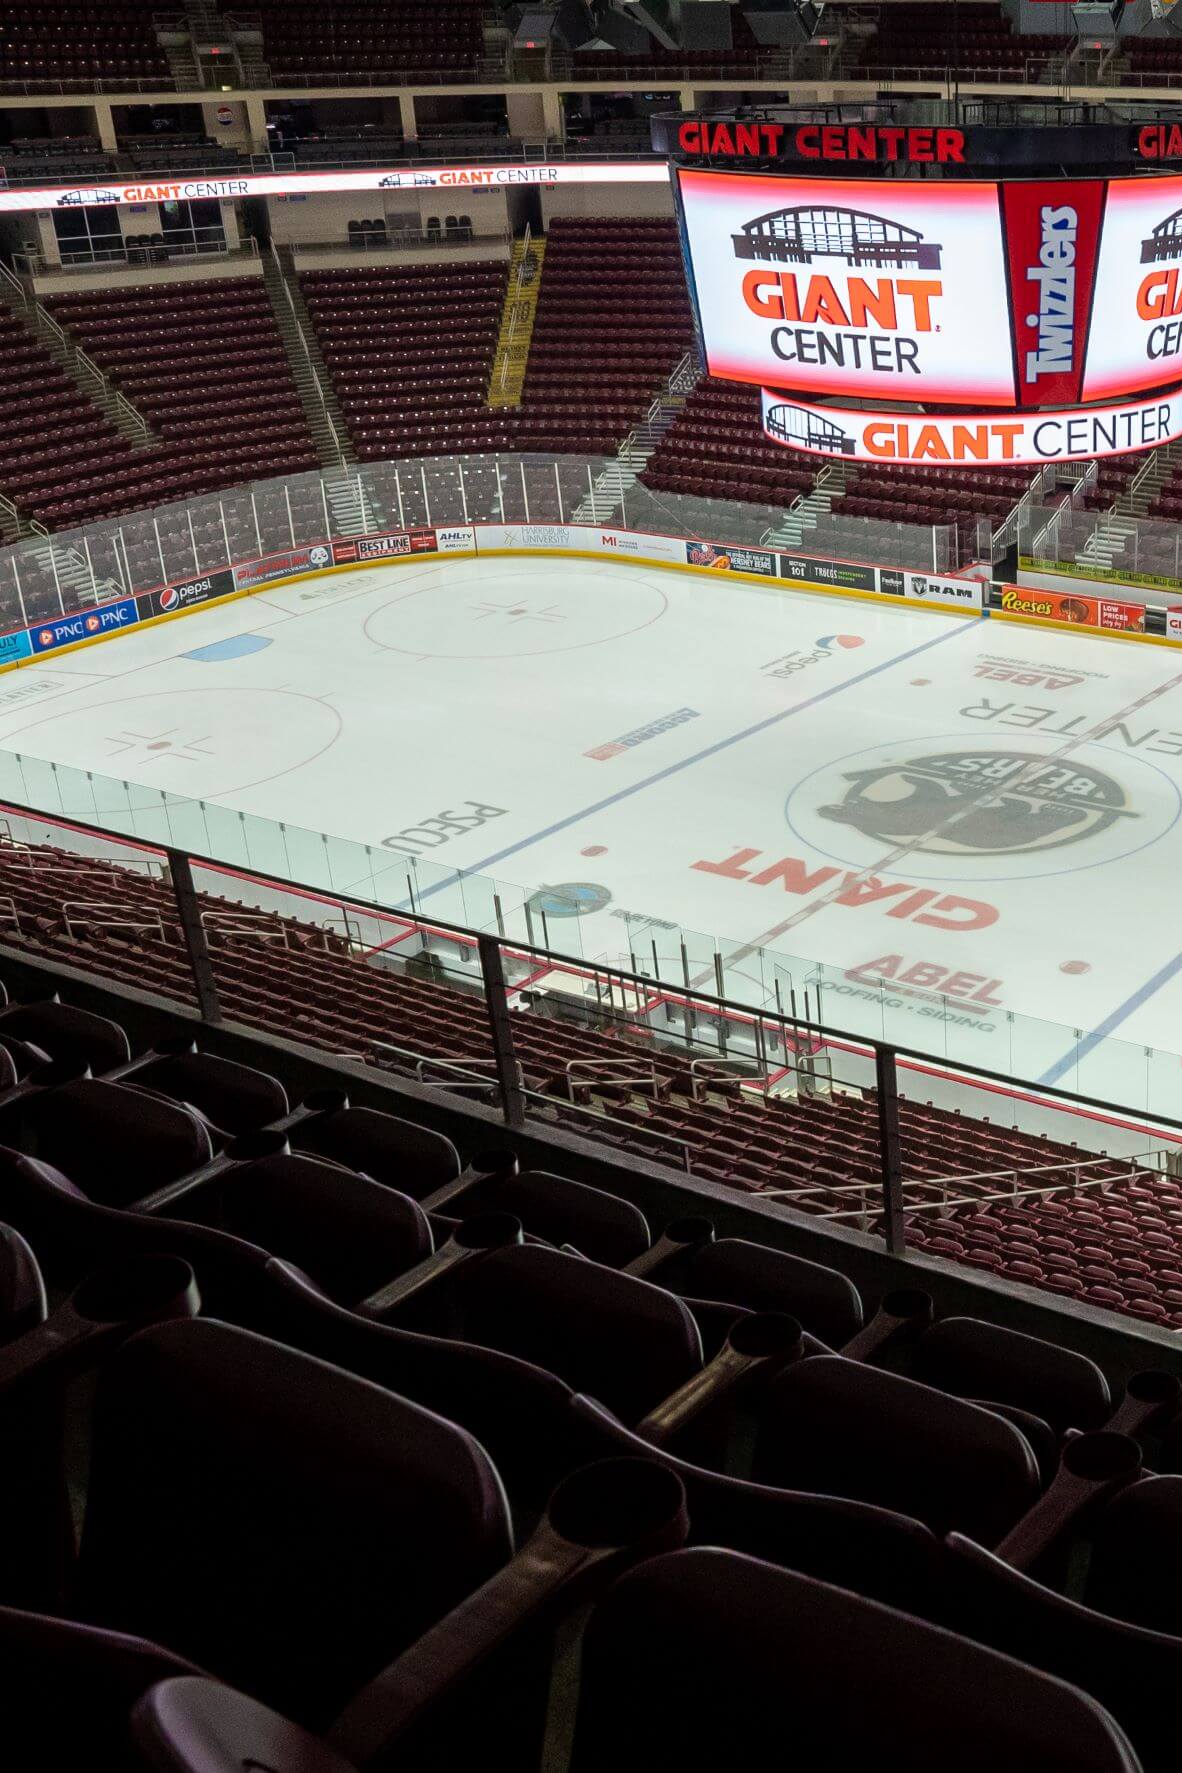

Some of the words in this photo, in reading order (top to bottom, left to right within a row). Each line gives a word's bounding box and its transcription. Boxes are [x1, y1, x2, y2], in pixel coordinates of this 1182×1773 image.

[680, 122, 783, 157] GIANT
[796, 127, 967, 162] CENTER
[123, 185, 181, 202] GIANT
[184, 181, 248, 198] CENTER
[439, 171, 493, 184] GIANT
[497, 169, 558, 183] CENTER
[741, 269, 942, 332] GIANT
[1026, 204, 1078, 382] Twizzlers
[770, 327, 922, 374] CENTER
[863, 422, 1024, 459] GIANT
[1033, 404, 1171, 456] CENTER
[360, 541, 385, 553] BEST
[179, 577, 212, 600] pepsi
[929, 585, 973, 598] RAM
[1002, 590, 1052, 615] Reese's
[55, 621, 83, 640] PNC
[100, 608, 128, 626] PNC
[764, 647, 833, 680] pepsi
[971, 661, 1085, 691] ABEL
[380, 800, 511, 855] PSECU
[689, 847, 1000, 932] GIANT
[845, 953, 1004, 1014] ABEL
[803, 975, 901, 1010] ROOFING
[917, 1005, 997, 1033] SIDING
